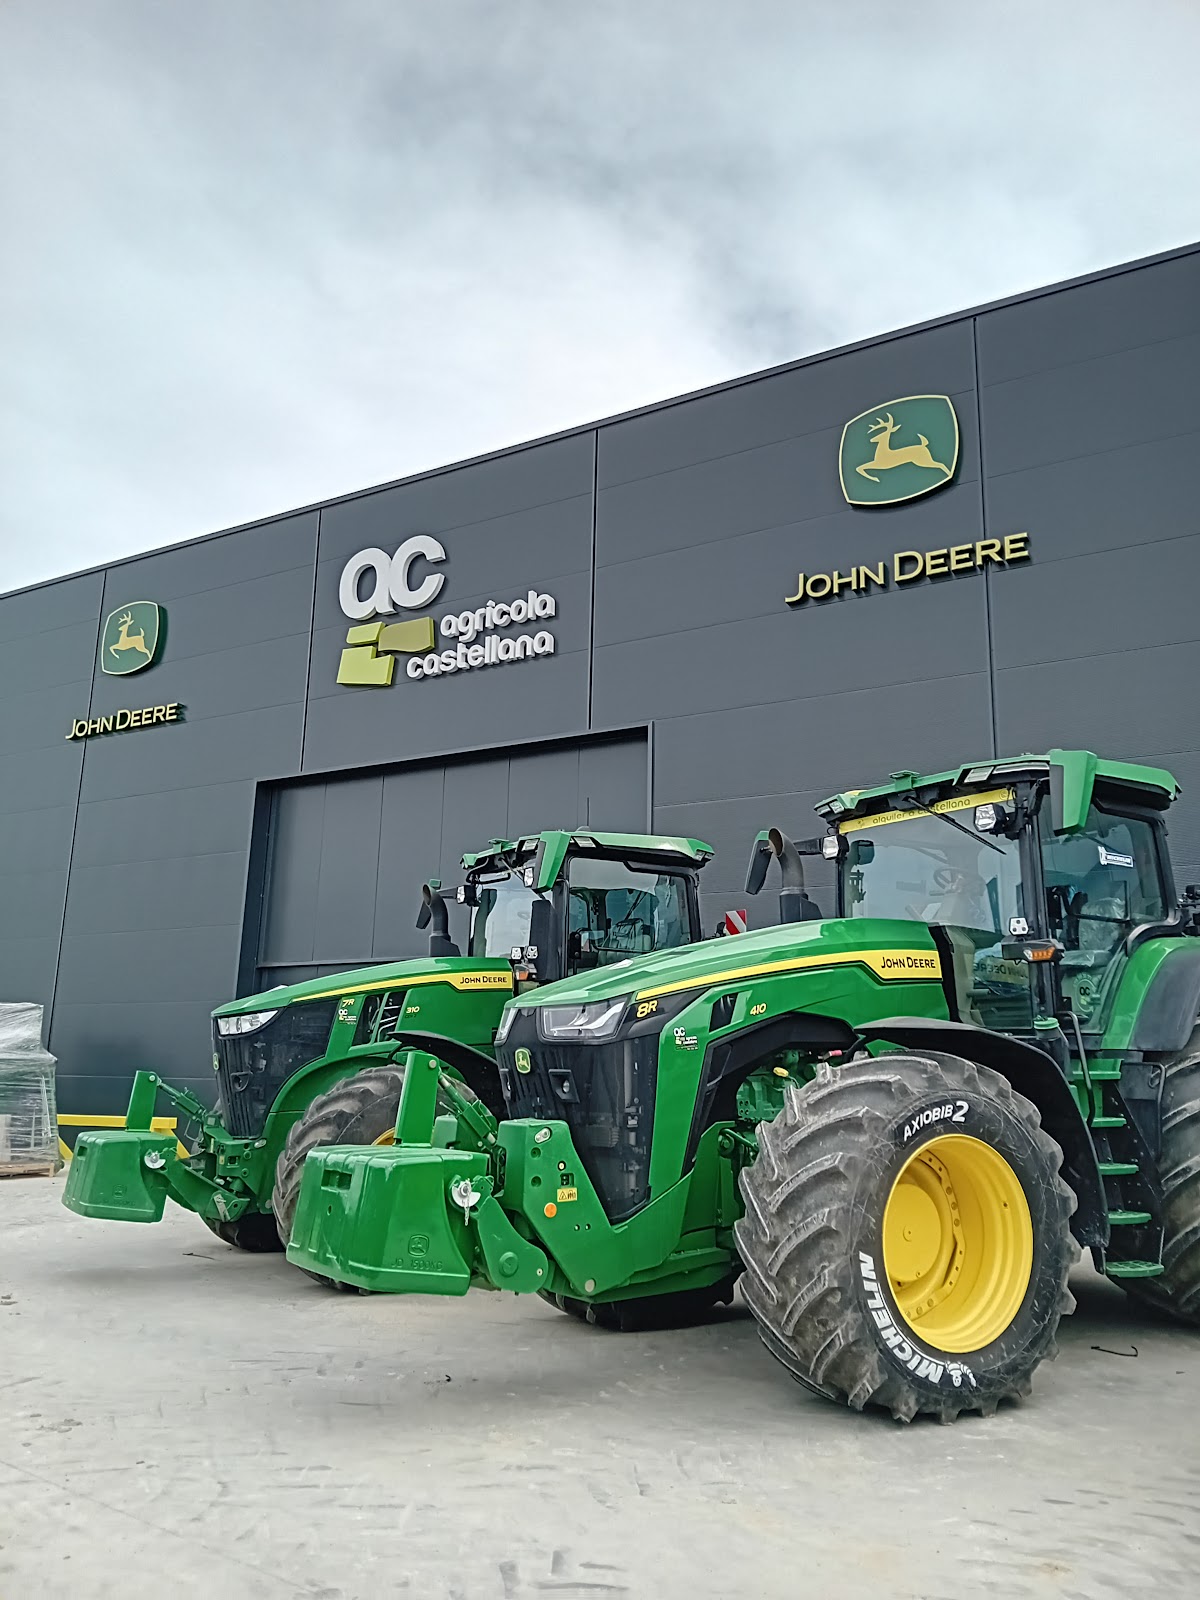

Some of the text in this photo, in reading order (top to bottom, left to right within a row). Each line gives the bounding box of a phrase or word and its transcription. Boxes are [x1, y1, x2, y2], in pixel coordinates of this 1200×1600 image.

[785, 532, 1029, 603] JOHN DEERE
[406, 631, 555, 679] castellana
[65, 703, 178, 740] JOHN DEERE
[881, 956, 936, 969] JOHN DEERE
[460, 975, 508, 984] JOHN DEERE
[342, 998, 355, 1007] 7R
[405, 1006, 420, 1014] 310
[636, 1000, 658, 1018] 8R
[750, 1003, 767, 1016] 410
[858, 1250, 944, 1384] MICHELIN
